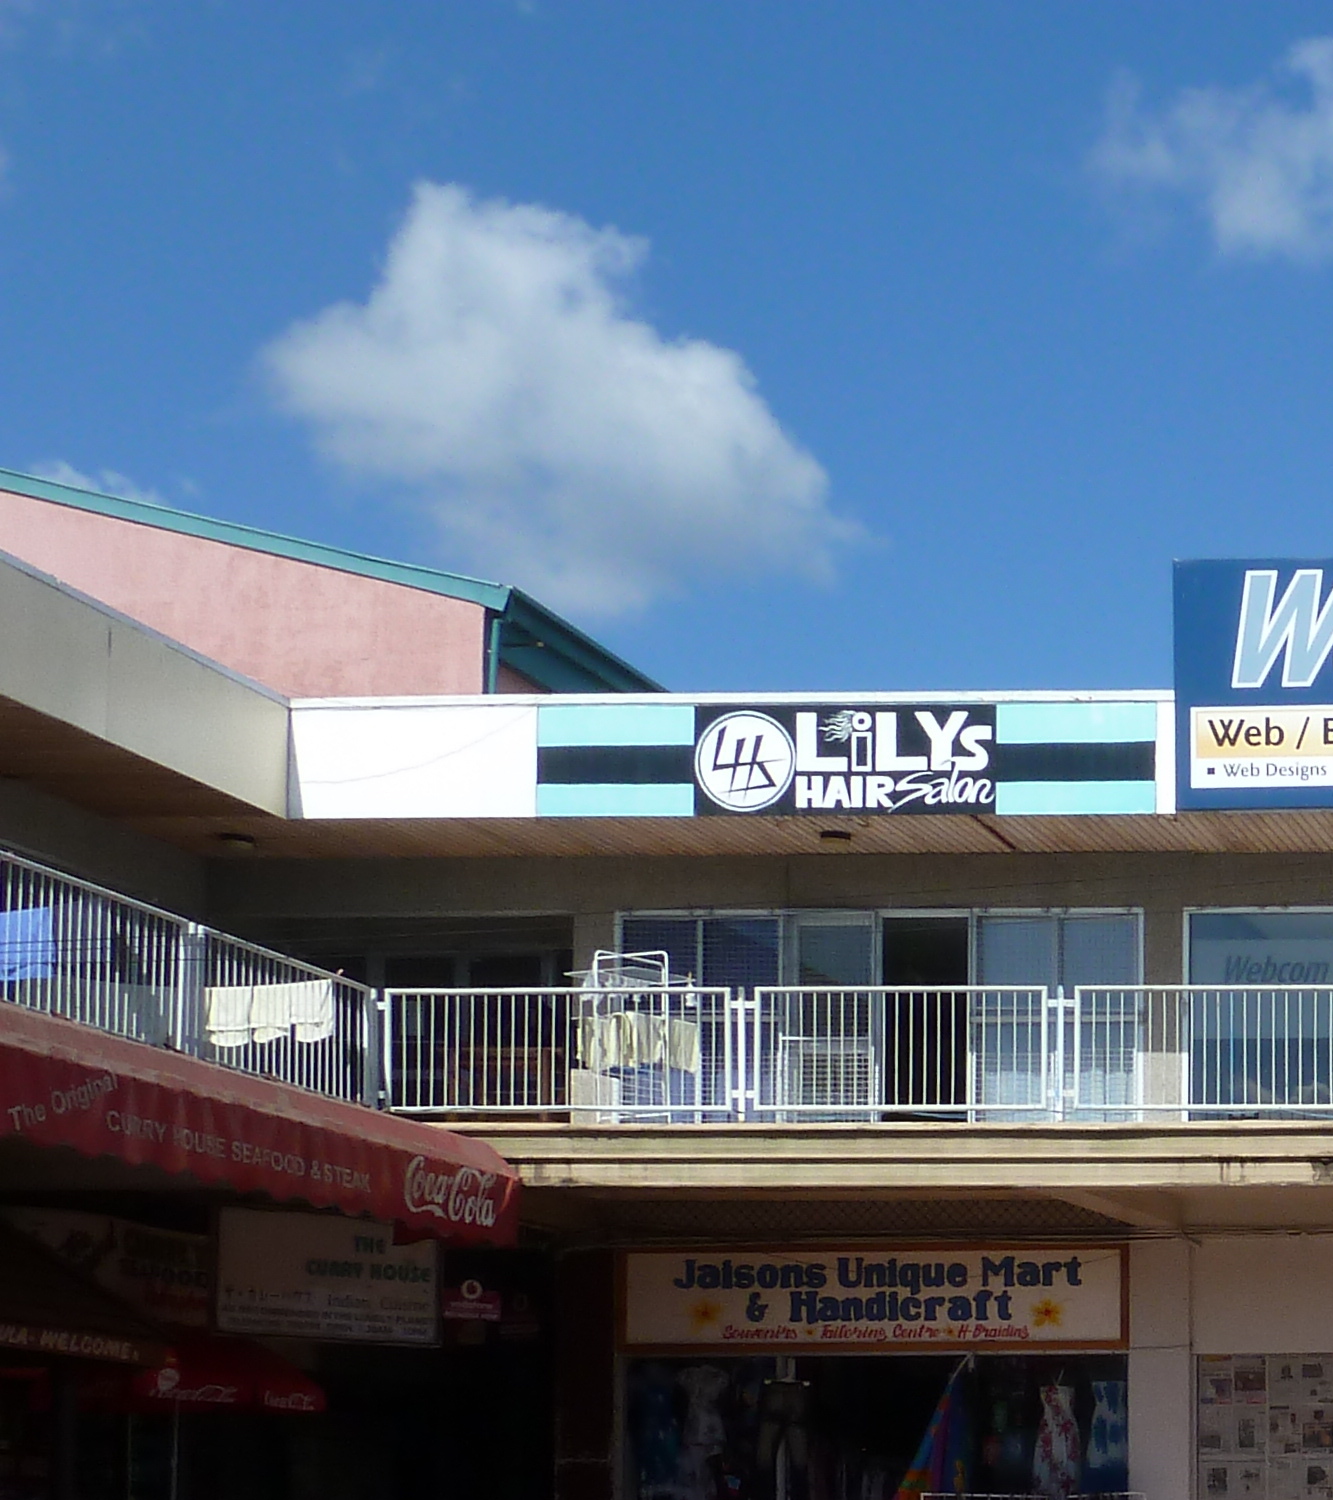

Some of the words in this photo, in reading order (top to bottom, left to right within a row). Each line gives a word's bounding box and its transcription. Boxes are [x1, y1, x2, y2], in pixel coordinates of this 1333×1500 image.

[1207, 716, 1285, 748] Web
[1295, 715, 1310, 751] /
[796, 775, 896, 809] HAIR
[888, 762, 995, 812] Salon
[1222, 762, 1261, 778] Web
[1265, 762, 1328, 781] Designs
[1224, 955, 1331, 983] Webcom
[8, 1104, 47, 1132] The
[50, 1071, 120, 1116] Original
[105, 1110, 168, 1144] CURRY
[172, 1127, 227, 1160] HOUSE
[230, 1141, 306, 1178] SEAFOOD
[310, 1161, 322, 1179] &
[322, 1165, 373, 1194] STEAK
[403, 1155, 497, 1228] Coca-Cola
[305, 1259, 366, 1279] CURRY
[369, 1262, 431, 1284] HOUSE
[674, 1258, 829, 1292] Jaisons
[837, 1257, 969, 1296] Unique
[981, 1255, 1084, 1288] Mart
[747, 1291, 770, 1323] &
[790, 1290, 1014, 1324] Handicraft
